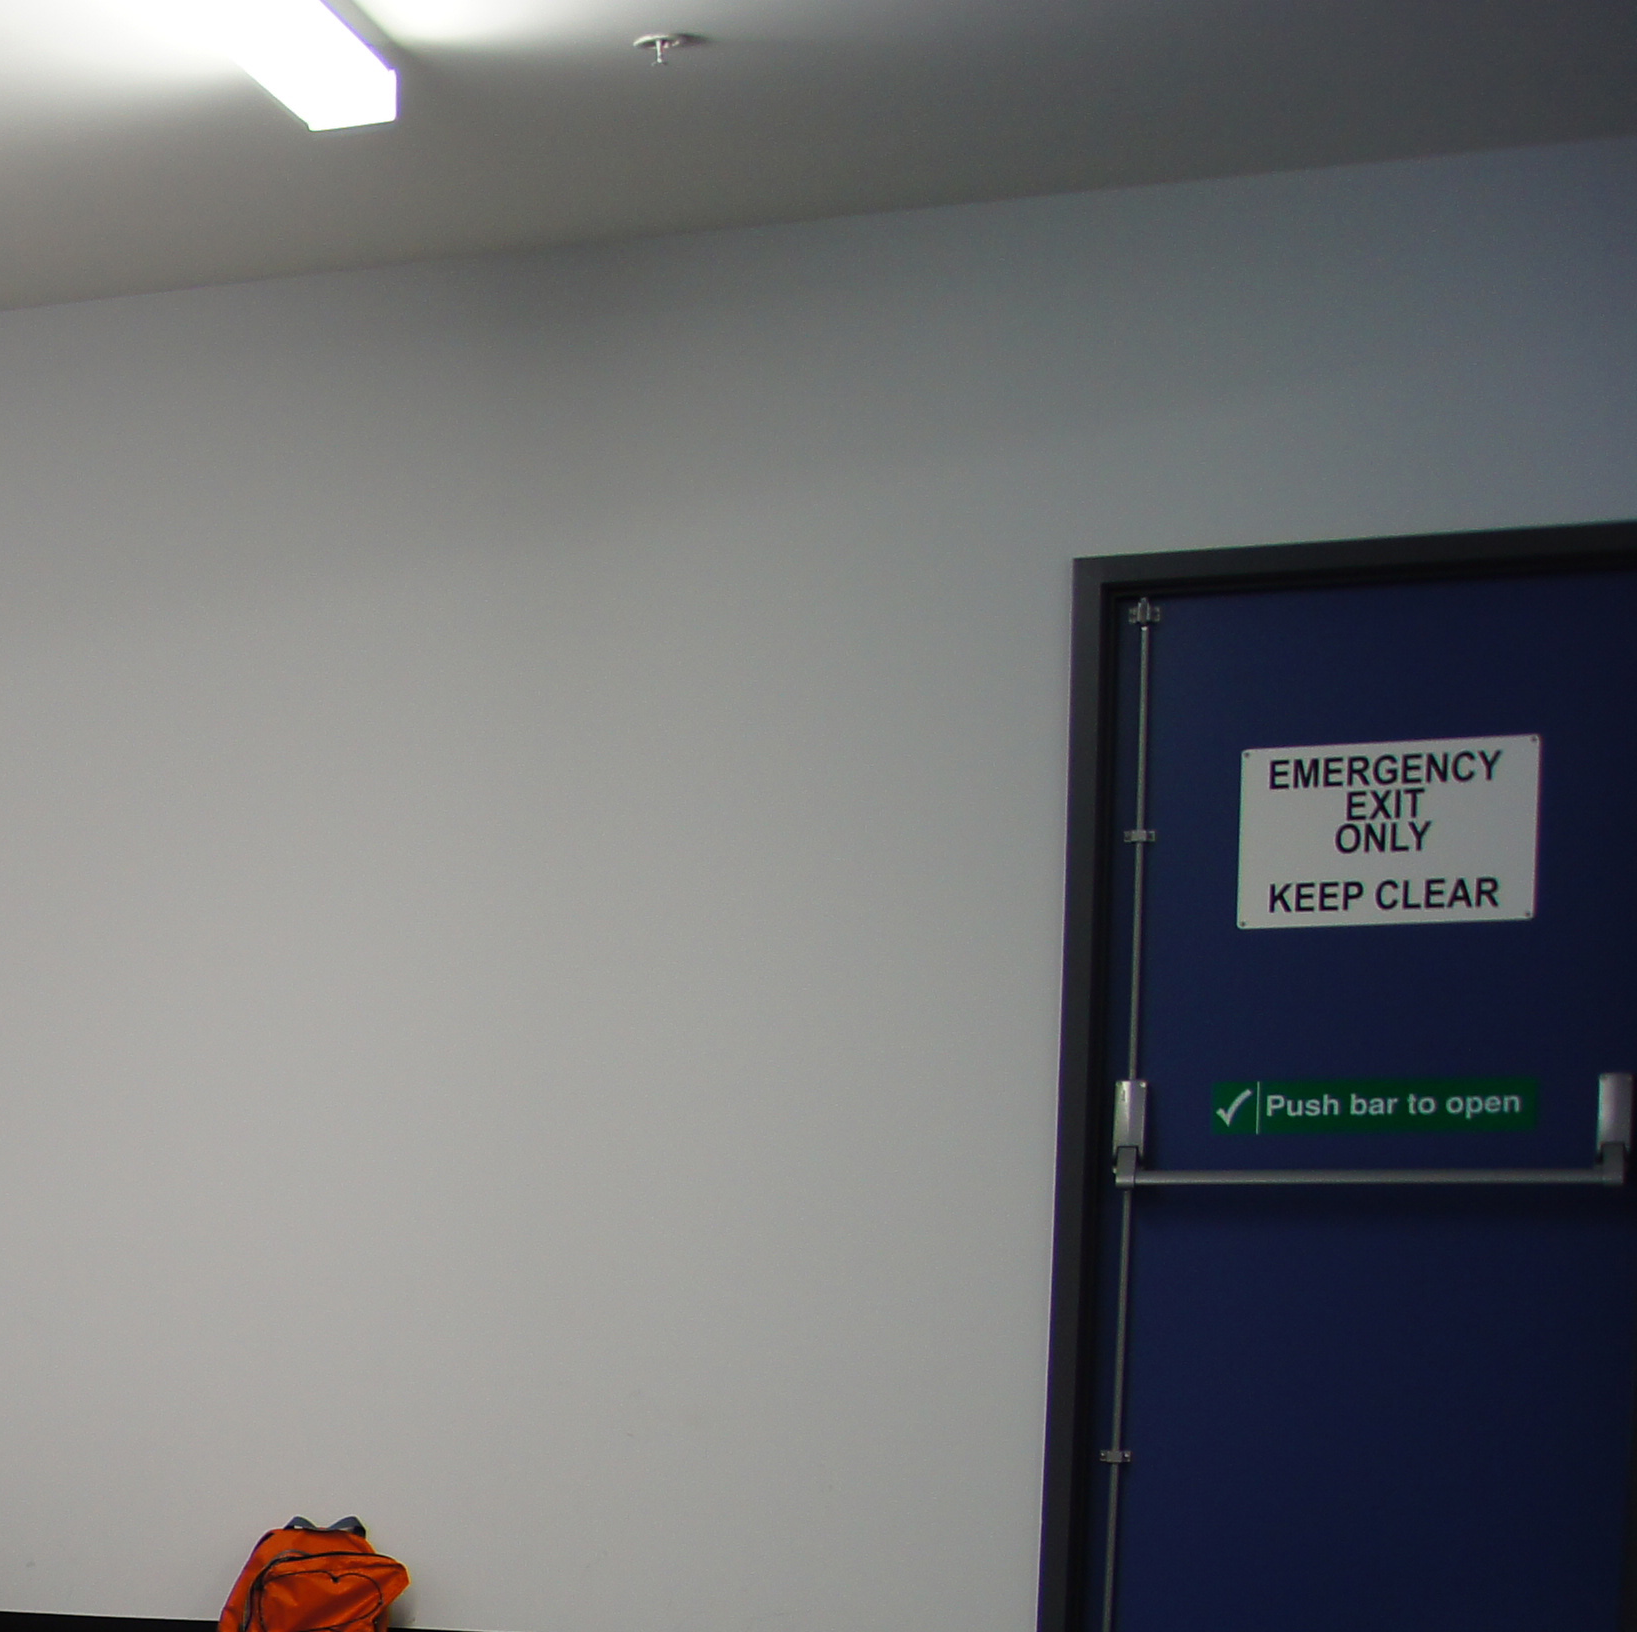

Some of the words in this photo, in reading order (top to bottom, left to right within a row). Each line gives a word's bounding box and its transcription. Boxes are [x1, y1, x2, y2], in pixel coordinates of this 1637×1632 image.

[1270, 750, 1501, 790] EMERGENCY
[1347, 789, 1425, 821] EXIT
[1336, 821, 1431, 853] ONLY
[1270, 882, 1363, 912] KEEP
[1376, 878, 1498, 909] CLEAR
[1267, 1094, 1339, 1116] Push
[1350, 1094, 1398, 1115] bar
[1408, 1094, 1435, 1114] to
[1446, 1096, 1519, 1118] open
